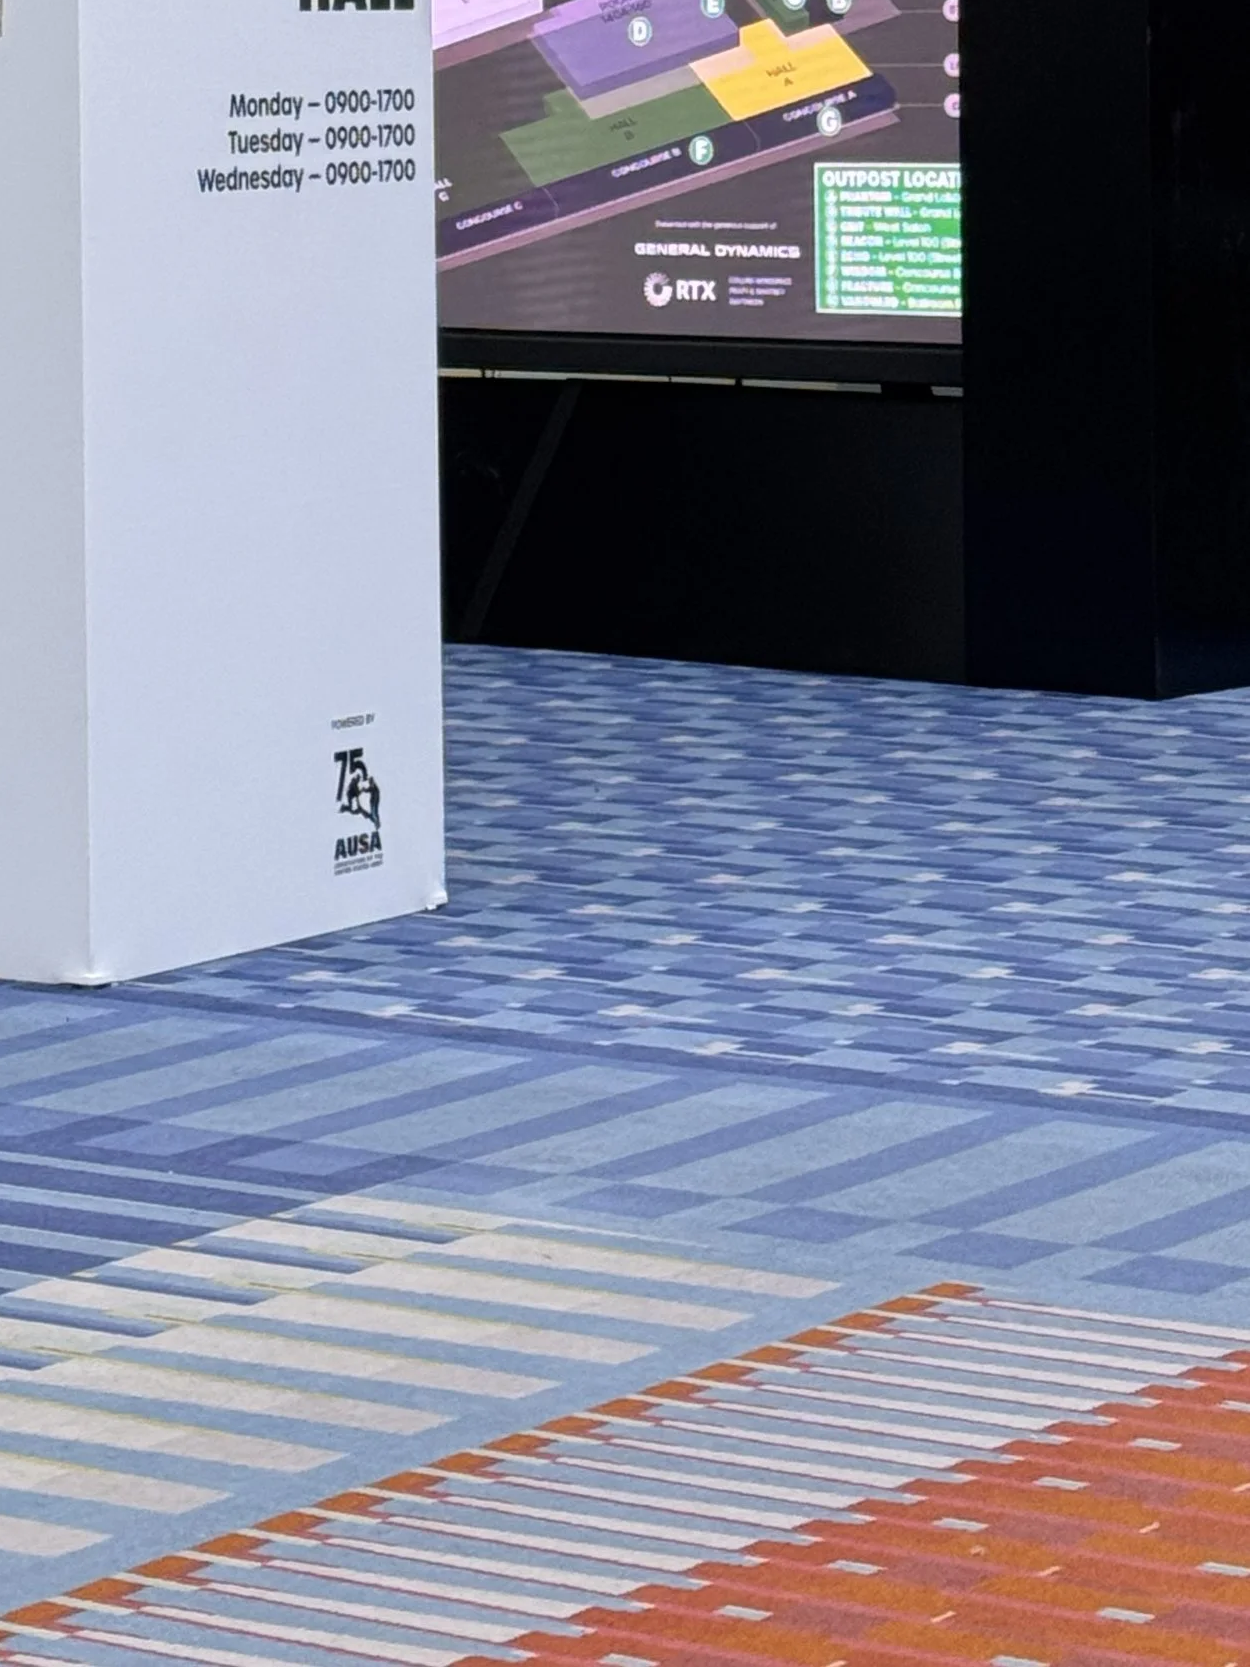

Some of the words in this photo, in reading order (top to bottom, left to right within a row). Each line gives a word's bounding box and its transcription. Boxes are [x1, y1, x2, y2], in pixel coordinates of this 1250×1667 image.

[229, 92, 303, 120] Monday
[325, 88, 415, 114] 0900-1700
[228, 128, 304, 157] Tuesday
[325, 124, 415, 150] 0900-1700
[197, 163, 304, 193] Wednesday
[325, 158, 416, 185] 0900-1700
[822, 170, 901, 188] OUTPOST
[634, 242, 711, 258] GENERAL
[714, 243, 801, 260] DYNAMICS
[676, 278, 717, 301] RTX
[333, 831, 383, 862] AUSA
